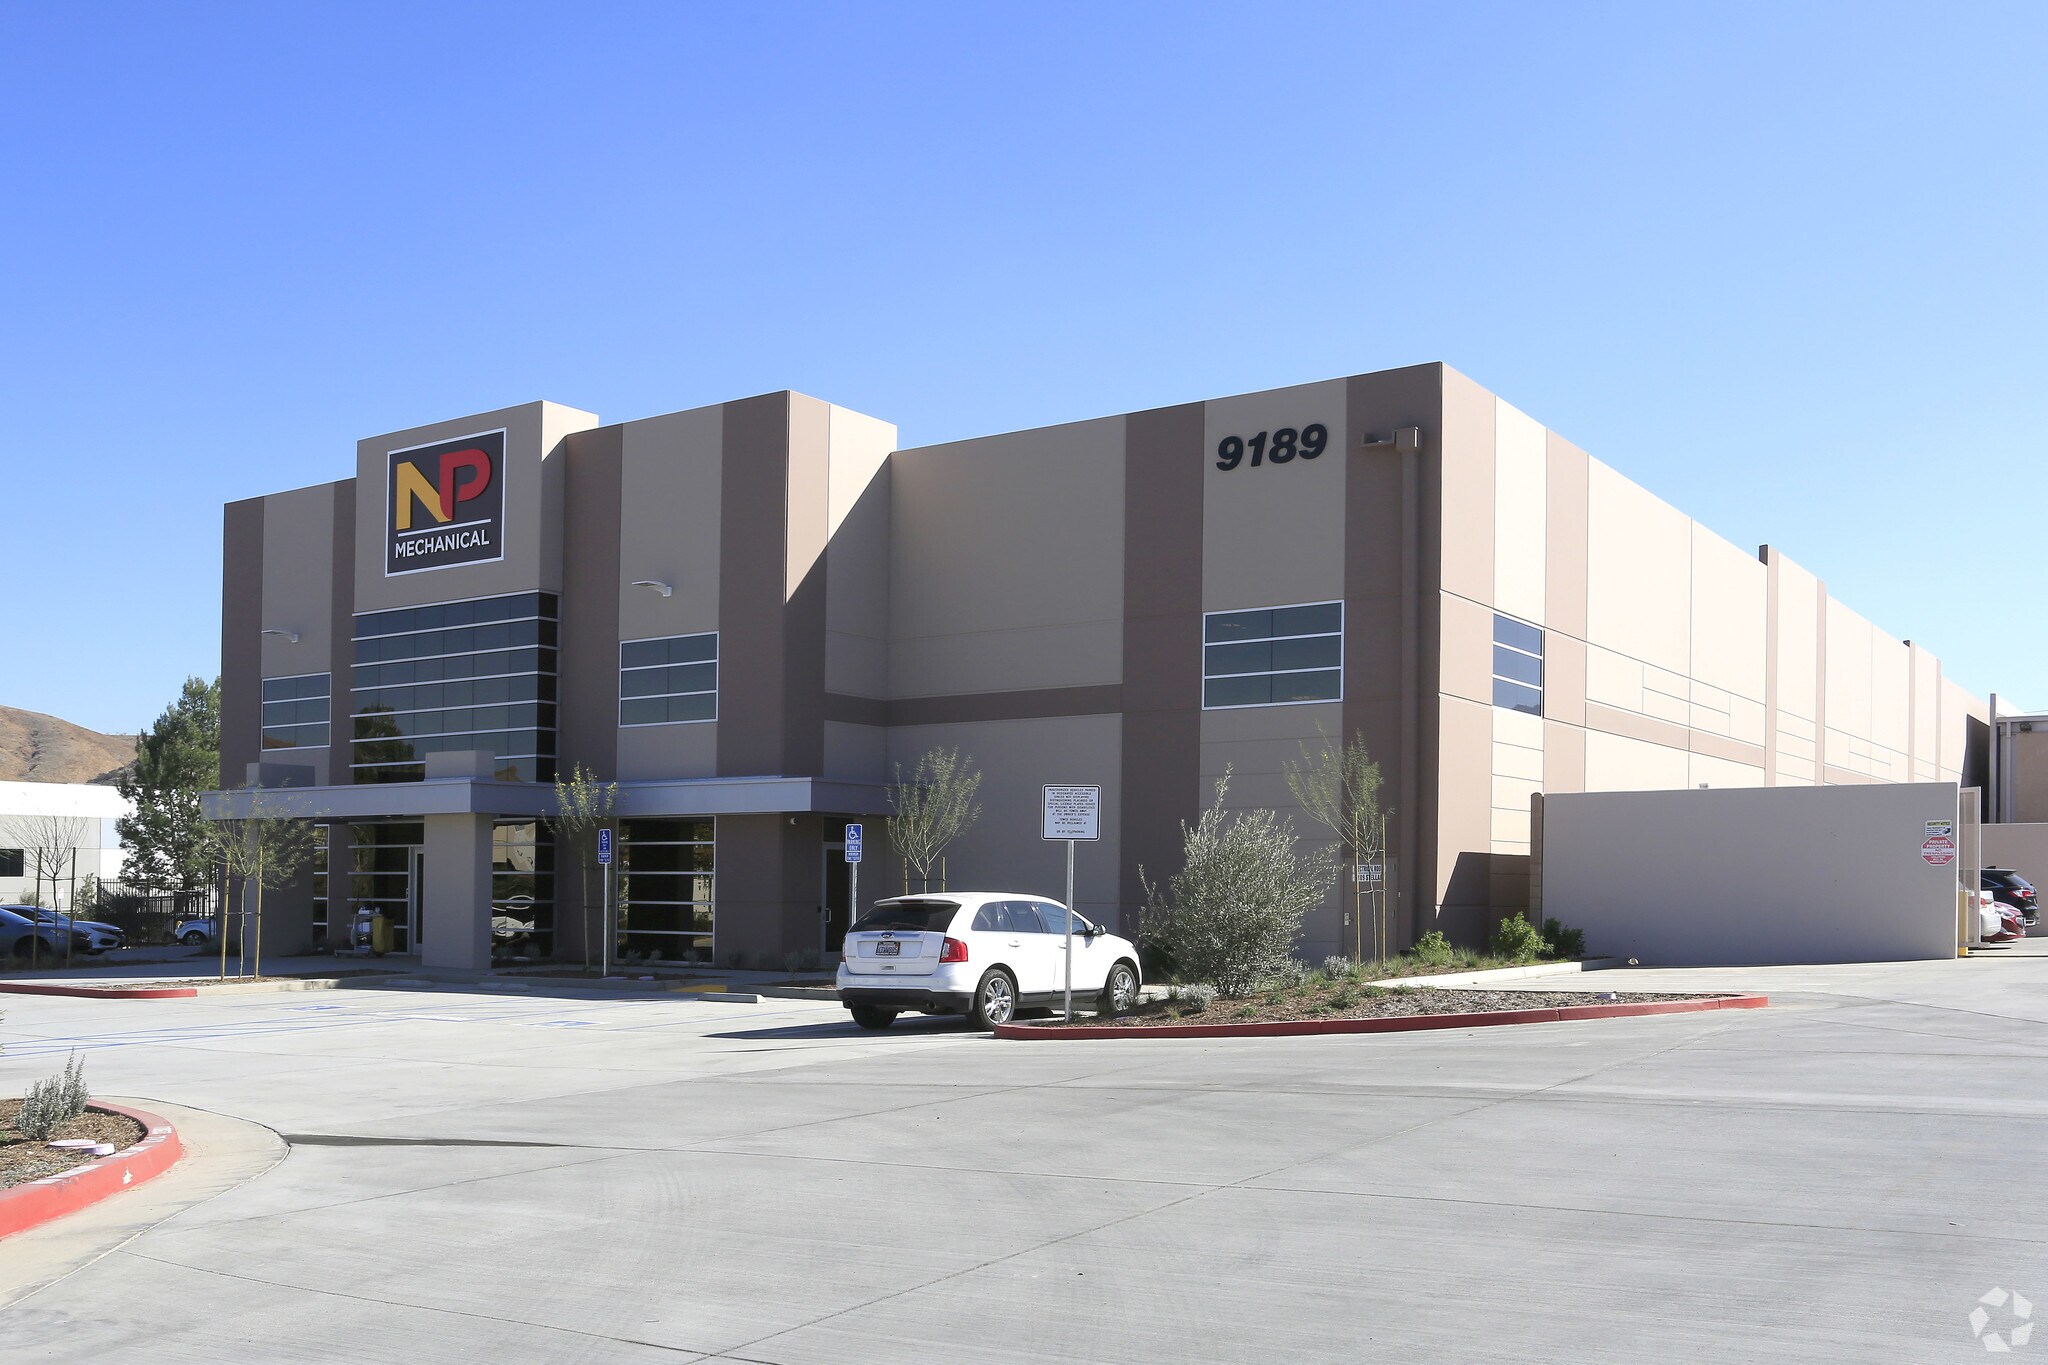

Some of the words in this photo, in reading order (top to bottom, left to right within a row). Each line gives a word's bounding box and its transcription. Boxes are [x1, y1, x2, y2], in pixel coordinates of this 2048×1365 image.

[1215, 423, 1328, 471] 9189
[396, 448, 492, 530] NP
[395, 529, 490, 559] MECHANICAL
